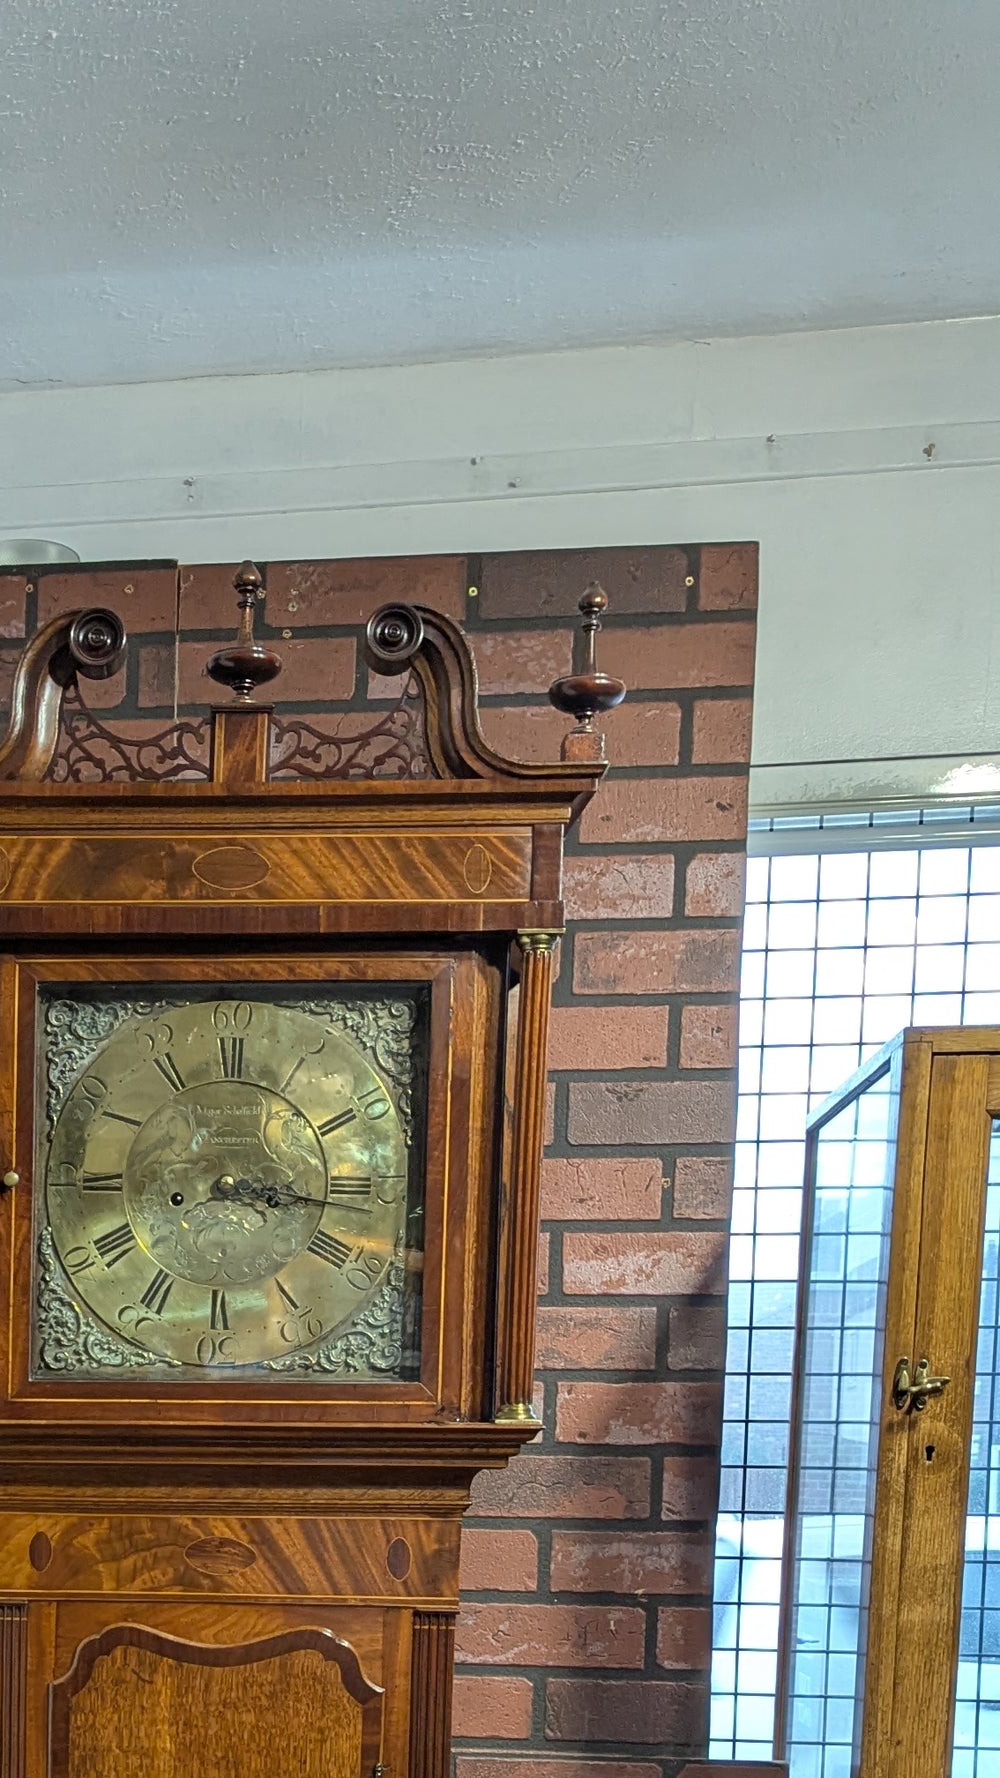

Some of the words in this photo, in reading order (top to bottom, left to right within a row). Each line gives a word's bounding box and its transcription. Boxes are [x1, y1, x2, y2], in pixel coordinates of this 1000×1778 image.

[210, 1002, 252, 1032] 60
[355, 1085, 391, 1121] 10
[329, 1175, 372, 1196] III
